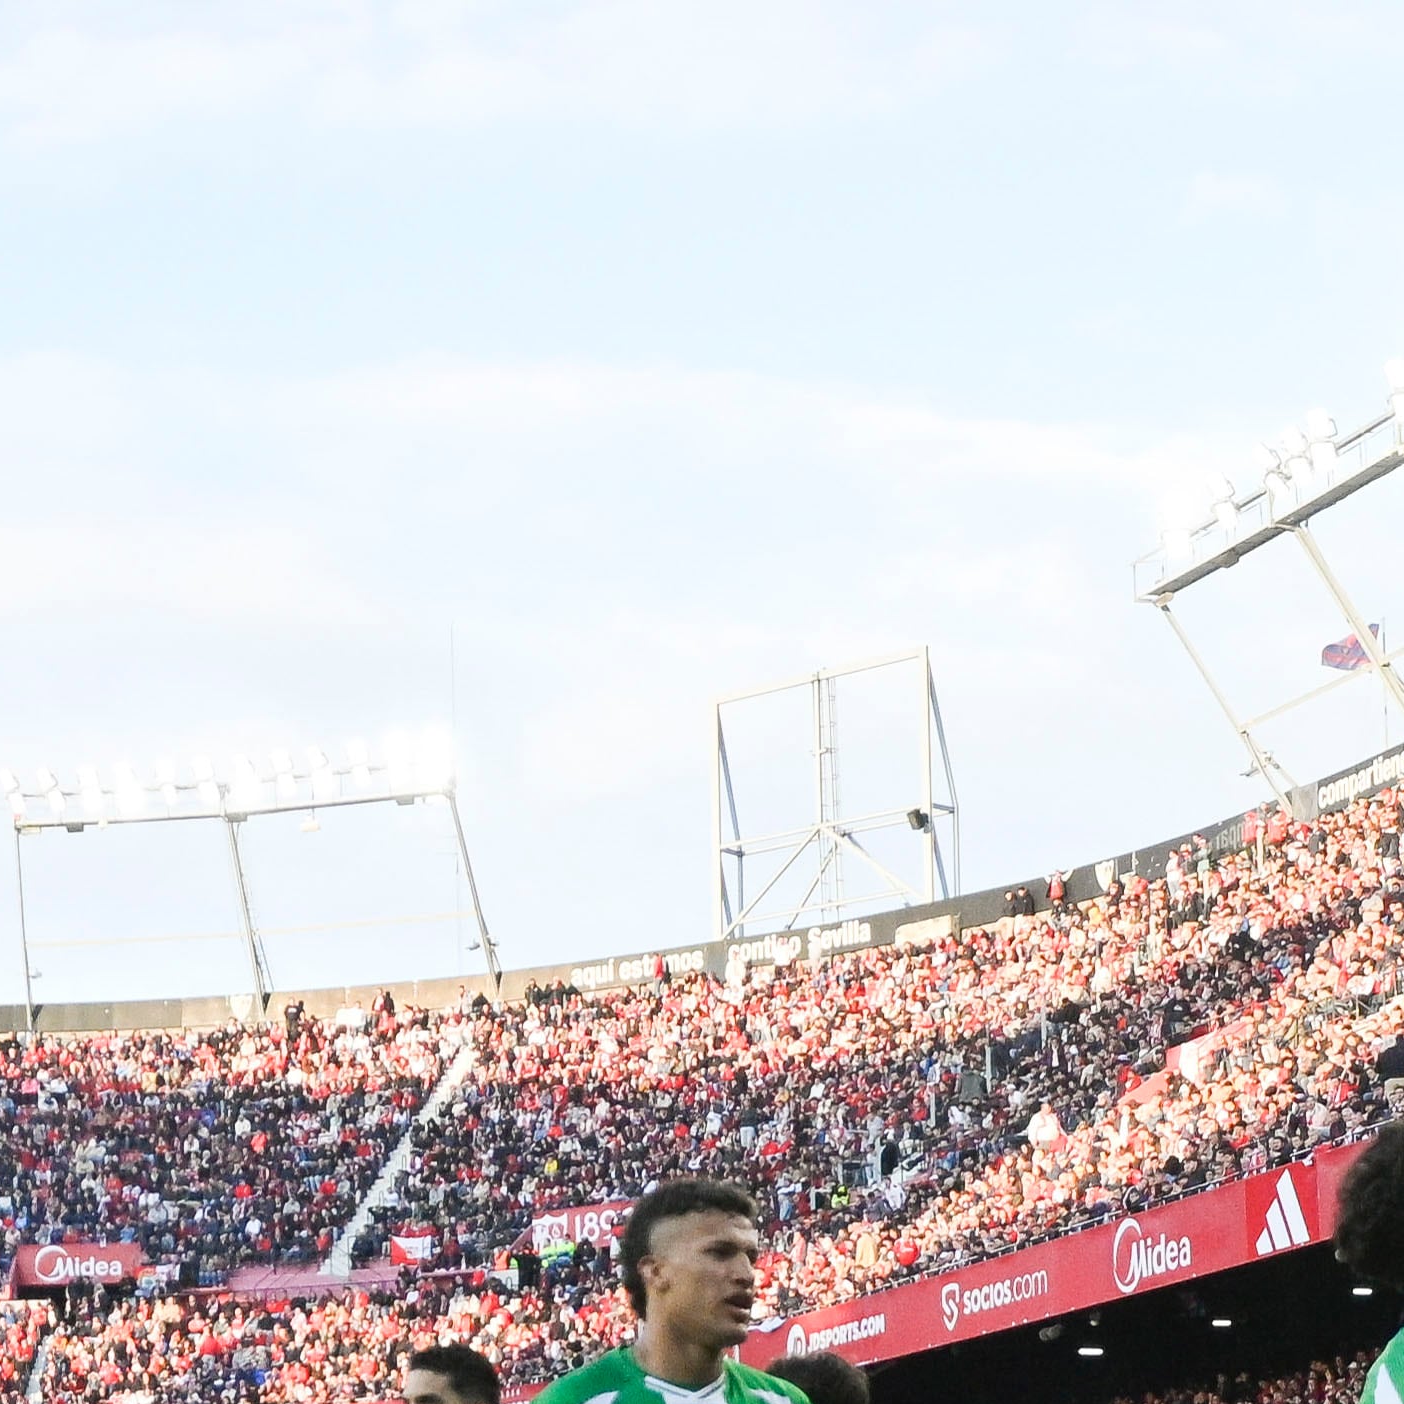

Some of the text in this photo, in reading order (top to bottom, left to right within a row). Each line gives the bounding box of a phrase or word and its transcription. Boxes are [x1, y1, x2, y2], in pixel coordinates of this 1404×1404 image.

[571, 958, 614, 991] aquí
[619, 949, 704, 982] estmos
[728, 934, 801, 967] contio
[42, 1251, 123, 1280] Midea
[1122, 1224, 1192, 1288] Midea
[806, 1312, 886, 1354] JDSPORTS.COM
